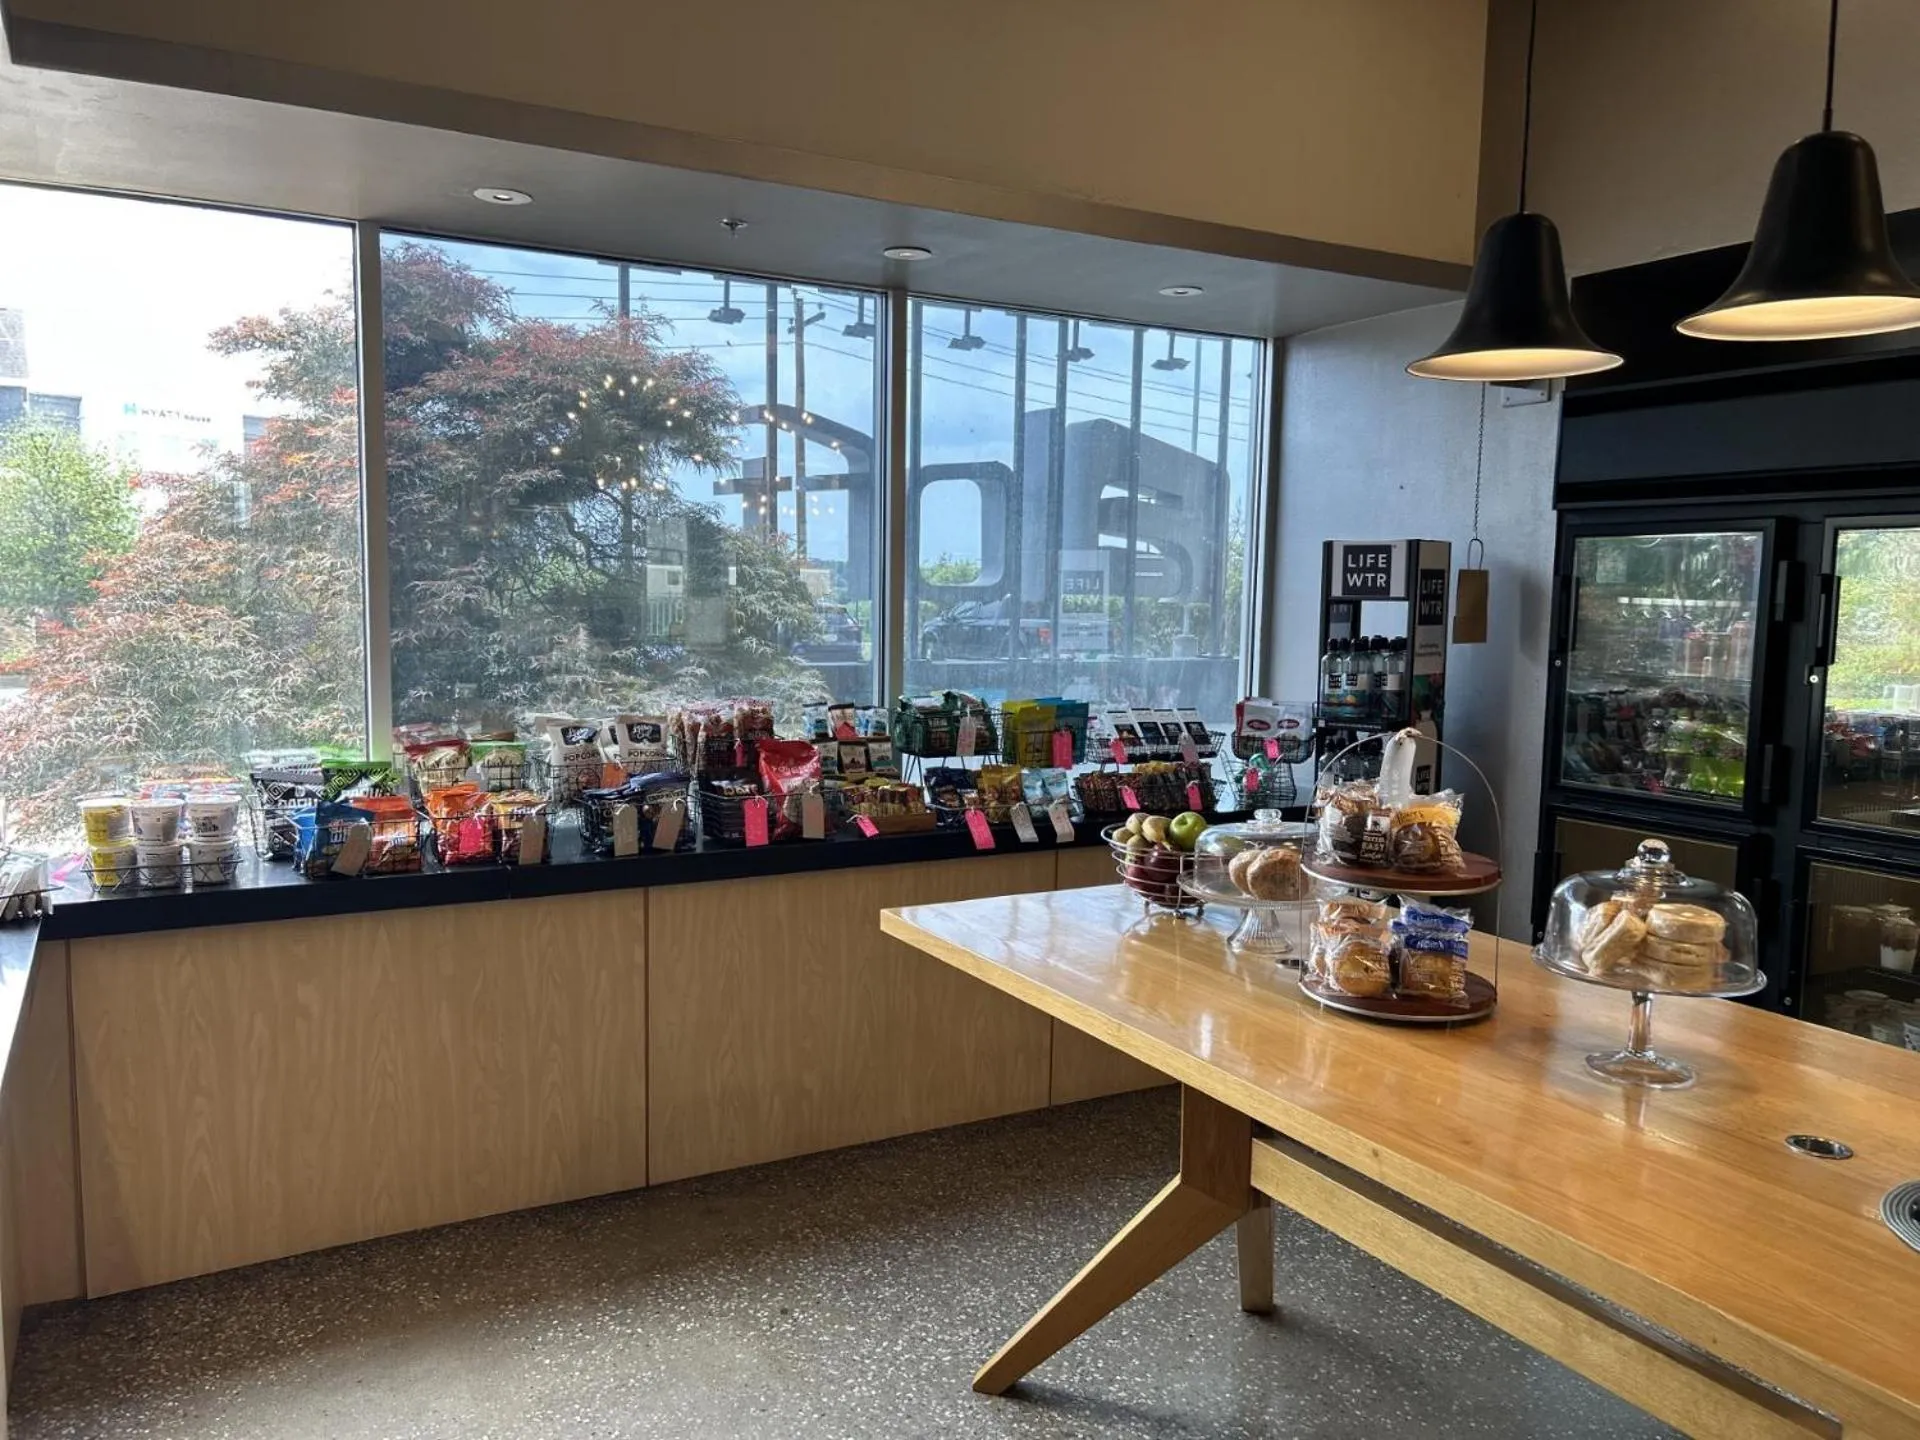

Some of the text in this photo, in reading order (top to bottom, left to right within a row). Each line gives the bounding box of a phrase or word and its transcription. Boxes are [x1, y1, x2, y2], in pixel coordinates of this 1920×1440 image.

[1347, 553, 1388, 568] LIFE
[1346, 573, 1387, 588] WTR
[1421, 579, 1444, 594] LIFE
[1420, 602, 1442, 615] WTR
[628, 749, 665, 759] POPCORN
